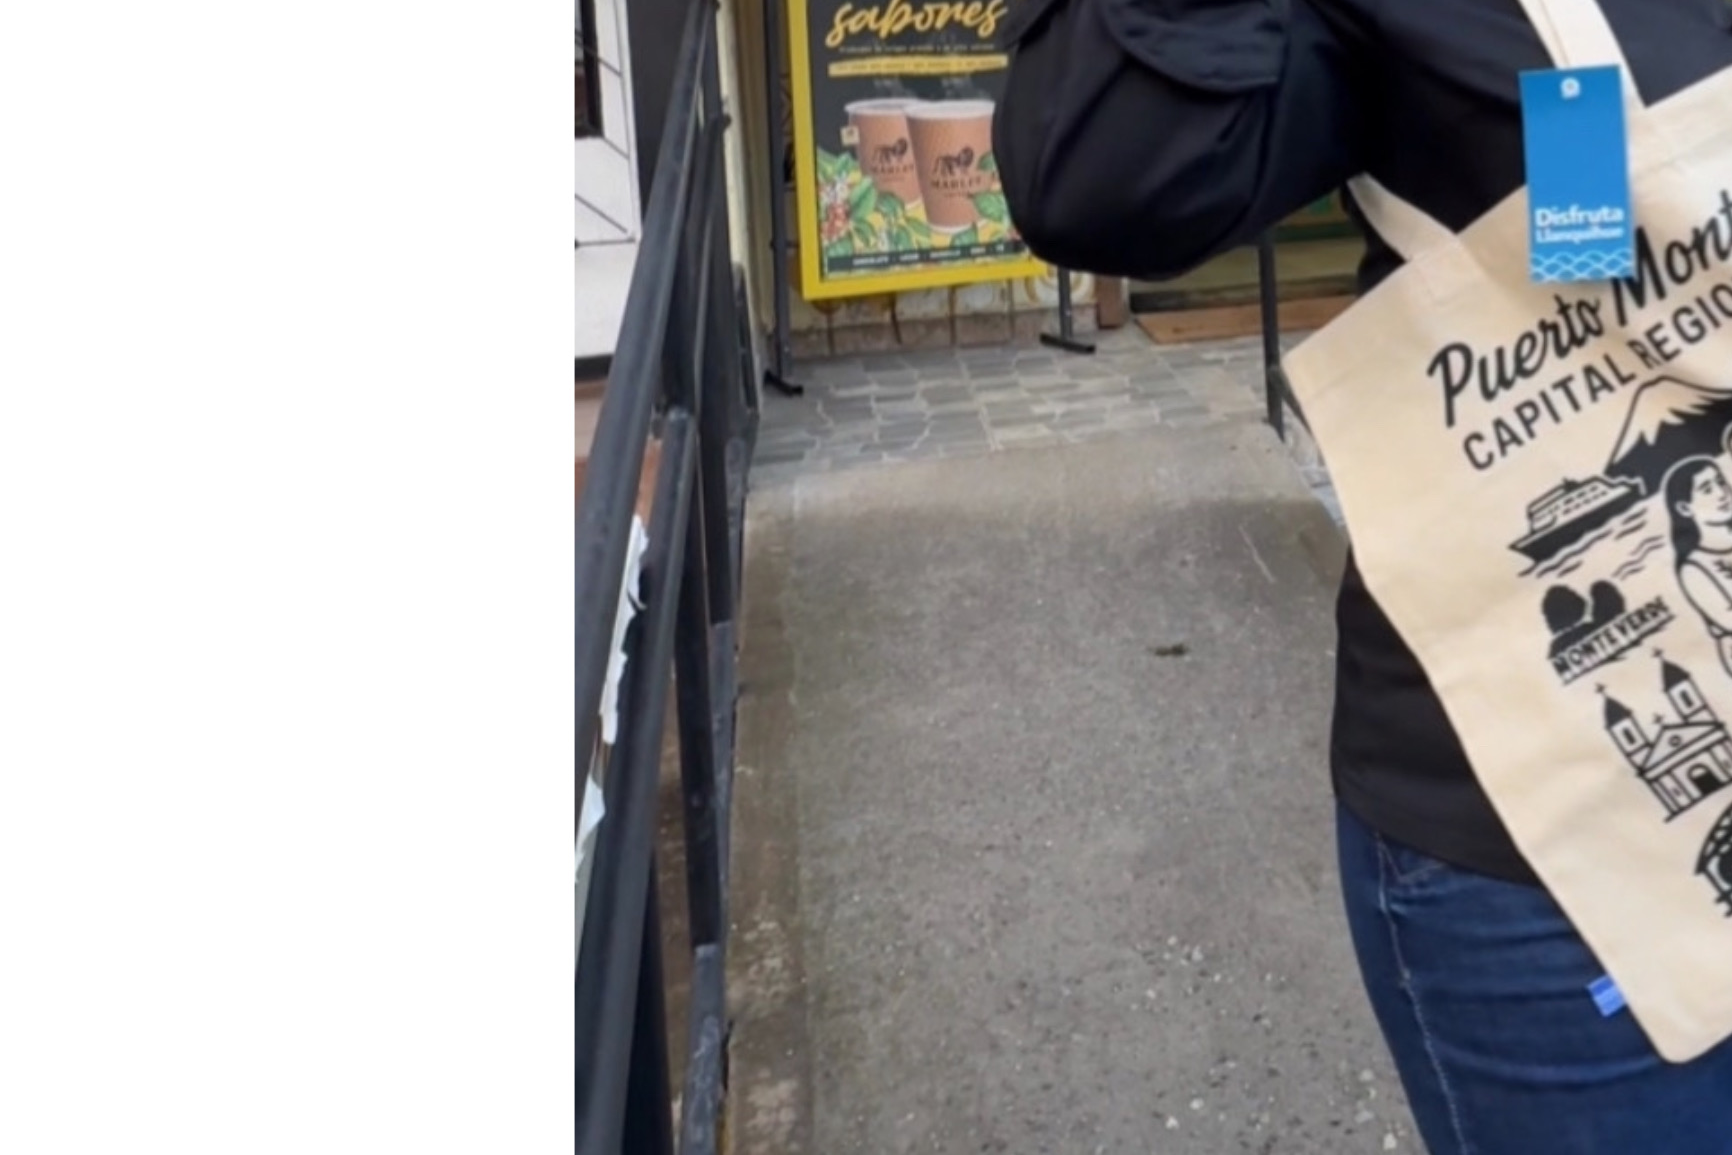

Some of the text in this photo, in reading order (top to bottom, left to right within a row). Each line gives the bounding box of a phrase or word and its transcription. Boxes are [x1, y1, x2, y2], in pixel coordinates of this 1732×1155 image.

[1534, 203, 1625, 227] Disfruta
[1426, 293, 1604, 428] Puerto
[1462, 354, 1637, 471] CAPITAL
